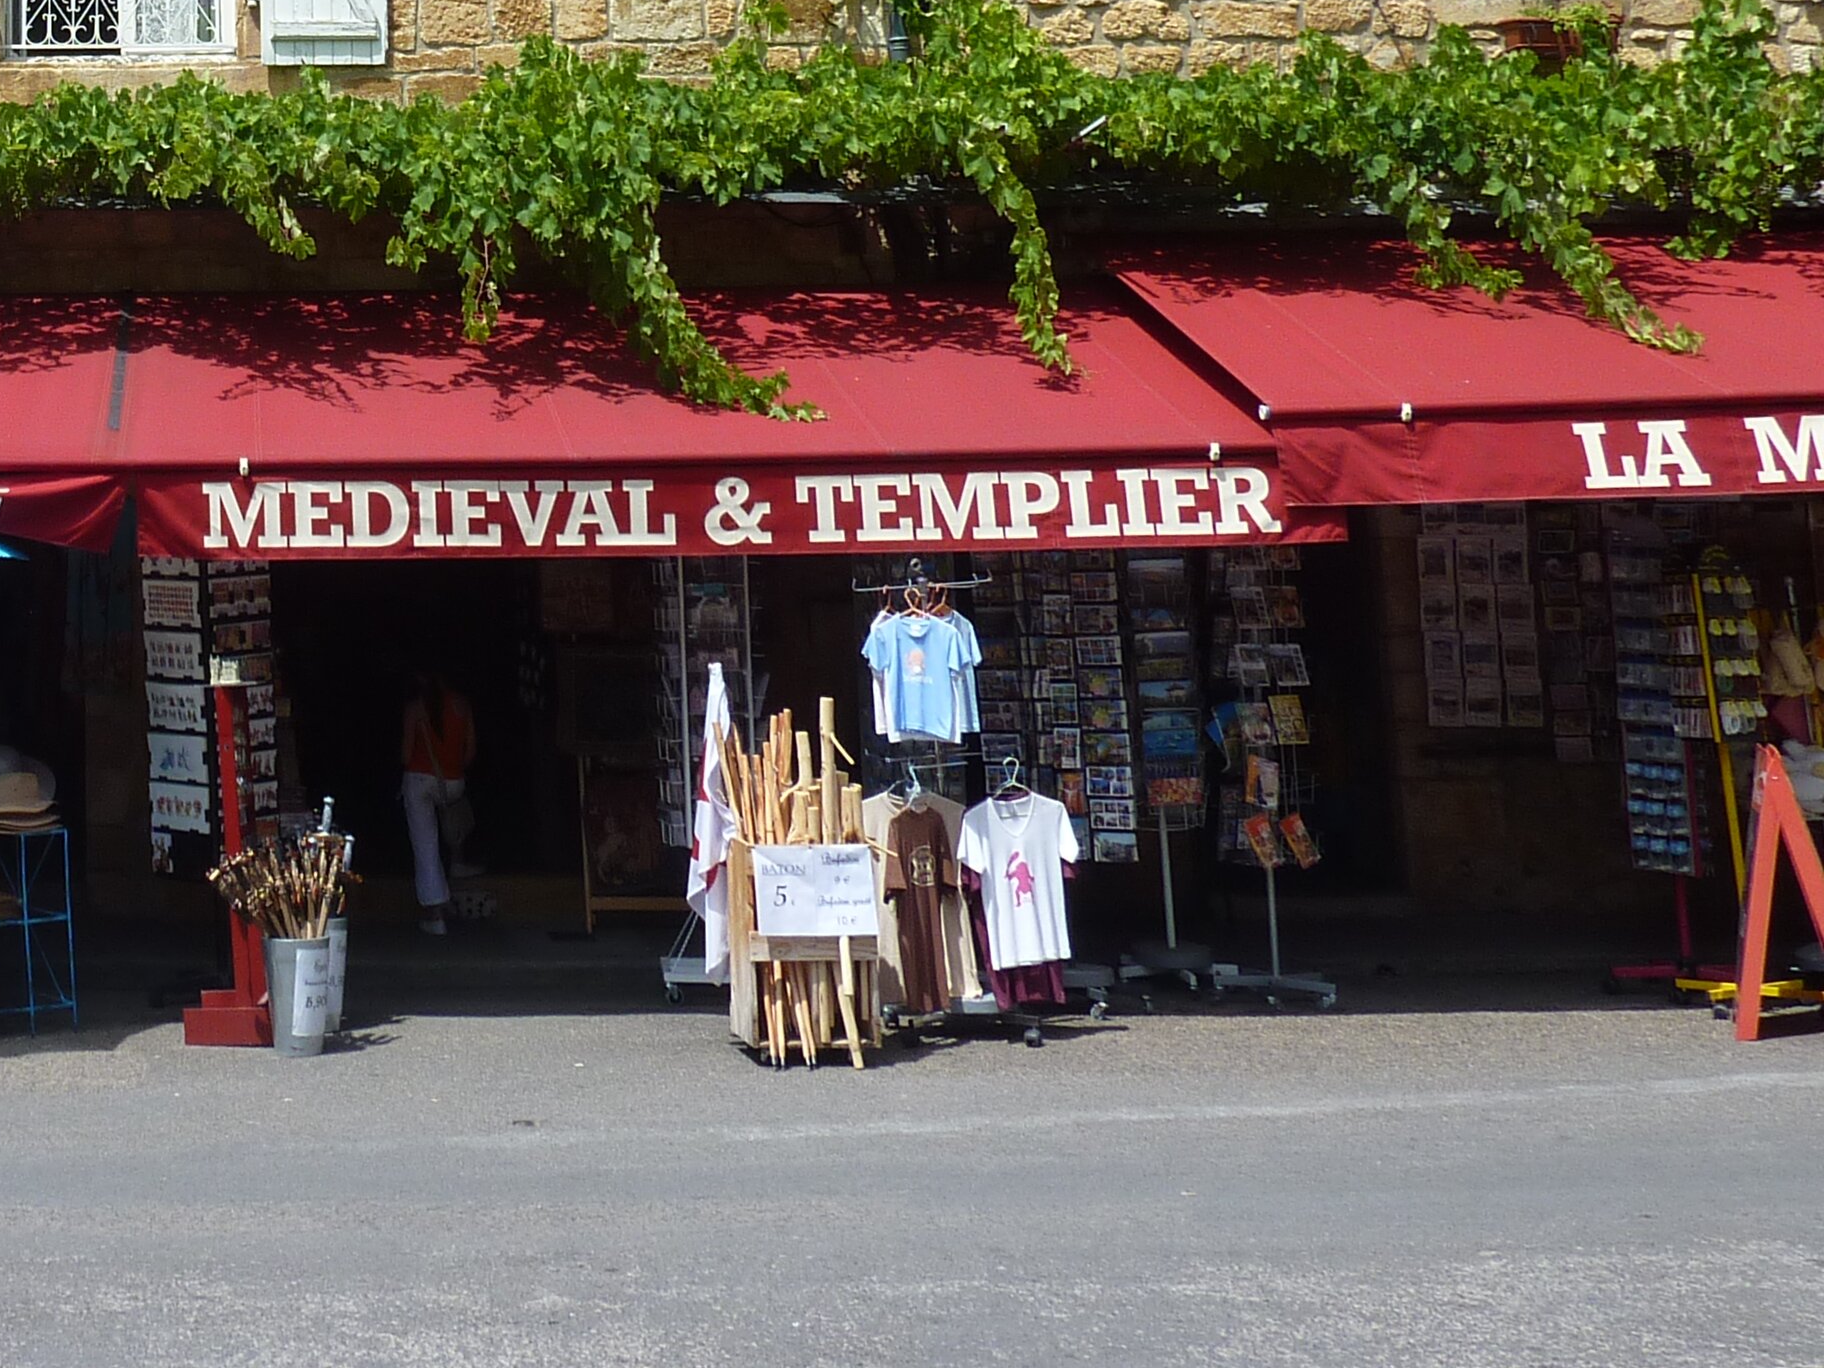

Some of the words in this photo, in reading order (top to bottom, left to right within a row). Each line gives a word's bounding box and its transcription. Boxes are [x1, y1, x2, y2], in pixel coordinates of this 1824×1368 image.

[1572, 419, 1712, 489] LA
[202, 480, 678, 549] MEDIEVAL
[704, 477, 773, 546] &
[795, 467, 1283, 543] TEMPLIER
[773, 885, 787, 907] 5
